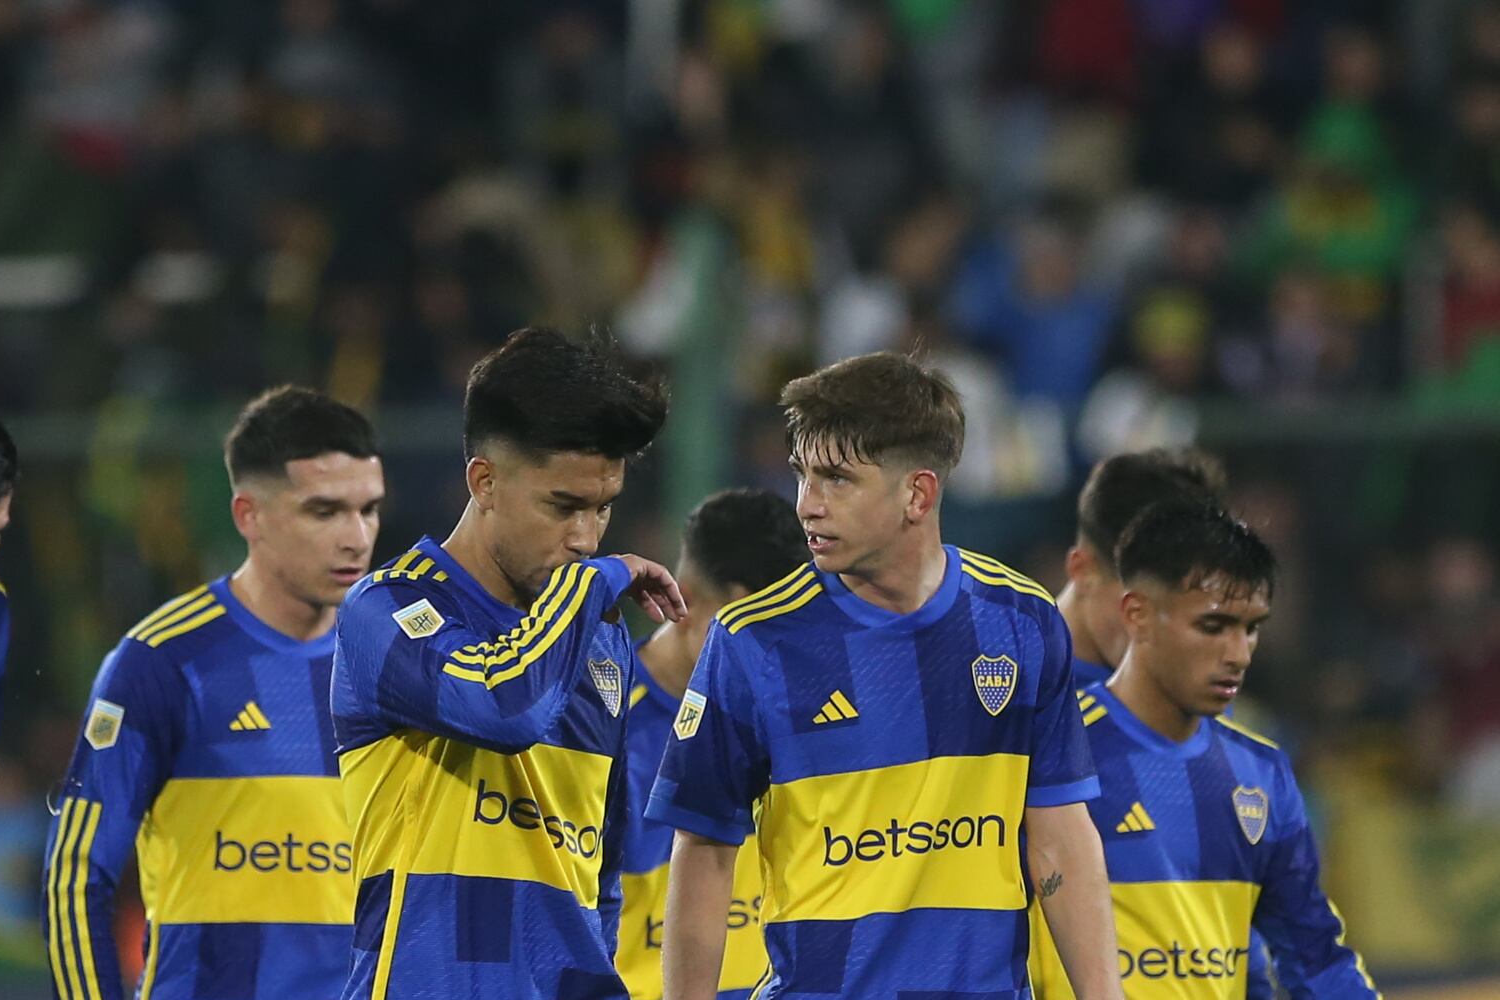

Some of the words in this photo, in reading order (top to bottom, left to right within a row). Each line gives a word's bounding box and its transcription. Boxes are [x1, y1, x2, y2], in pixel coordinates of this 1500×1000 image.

[977, 674, 1011, 687] CABJ
[214, 830, 352, 874] betss
[823, 814, 1005, 868] betsson
